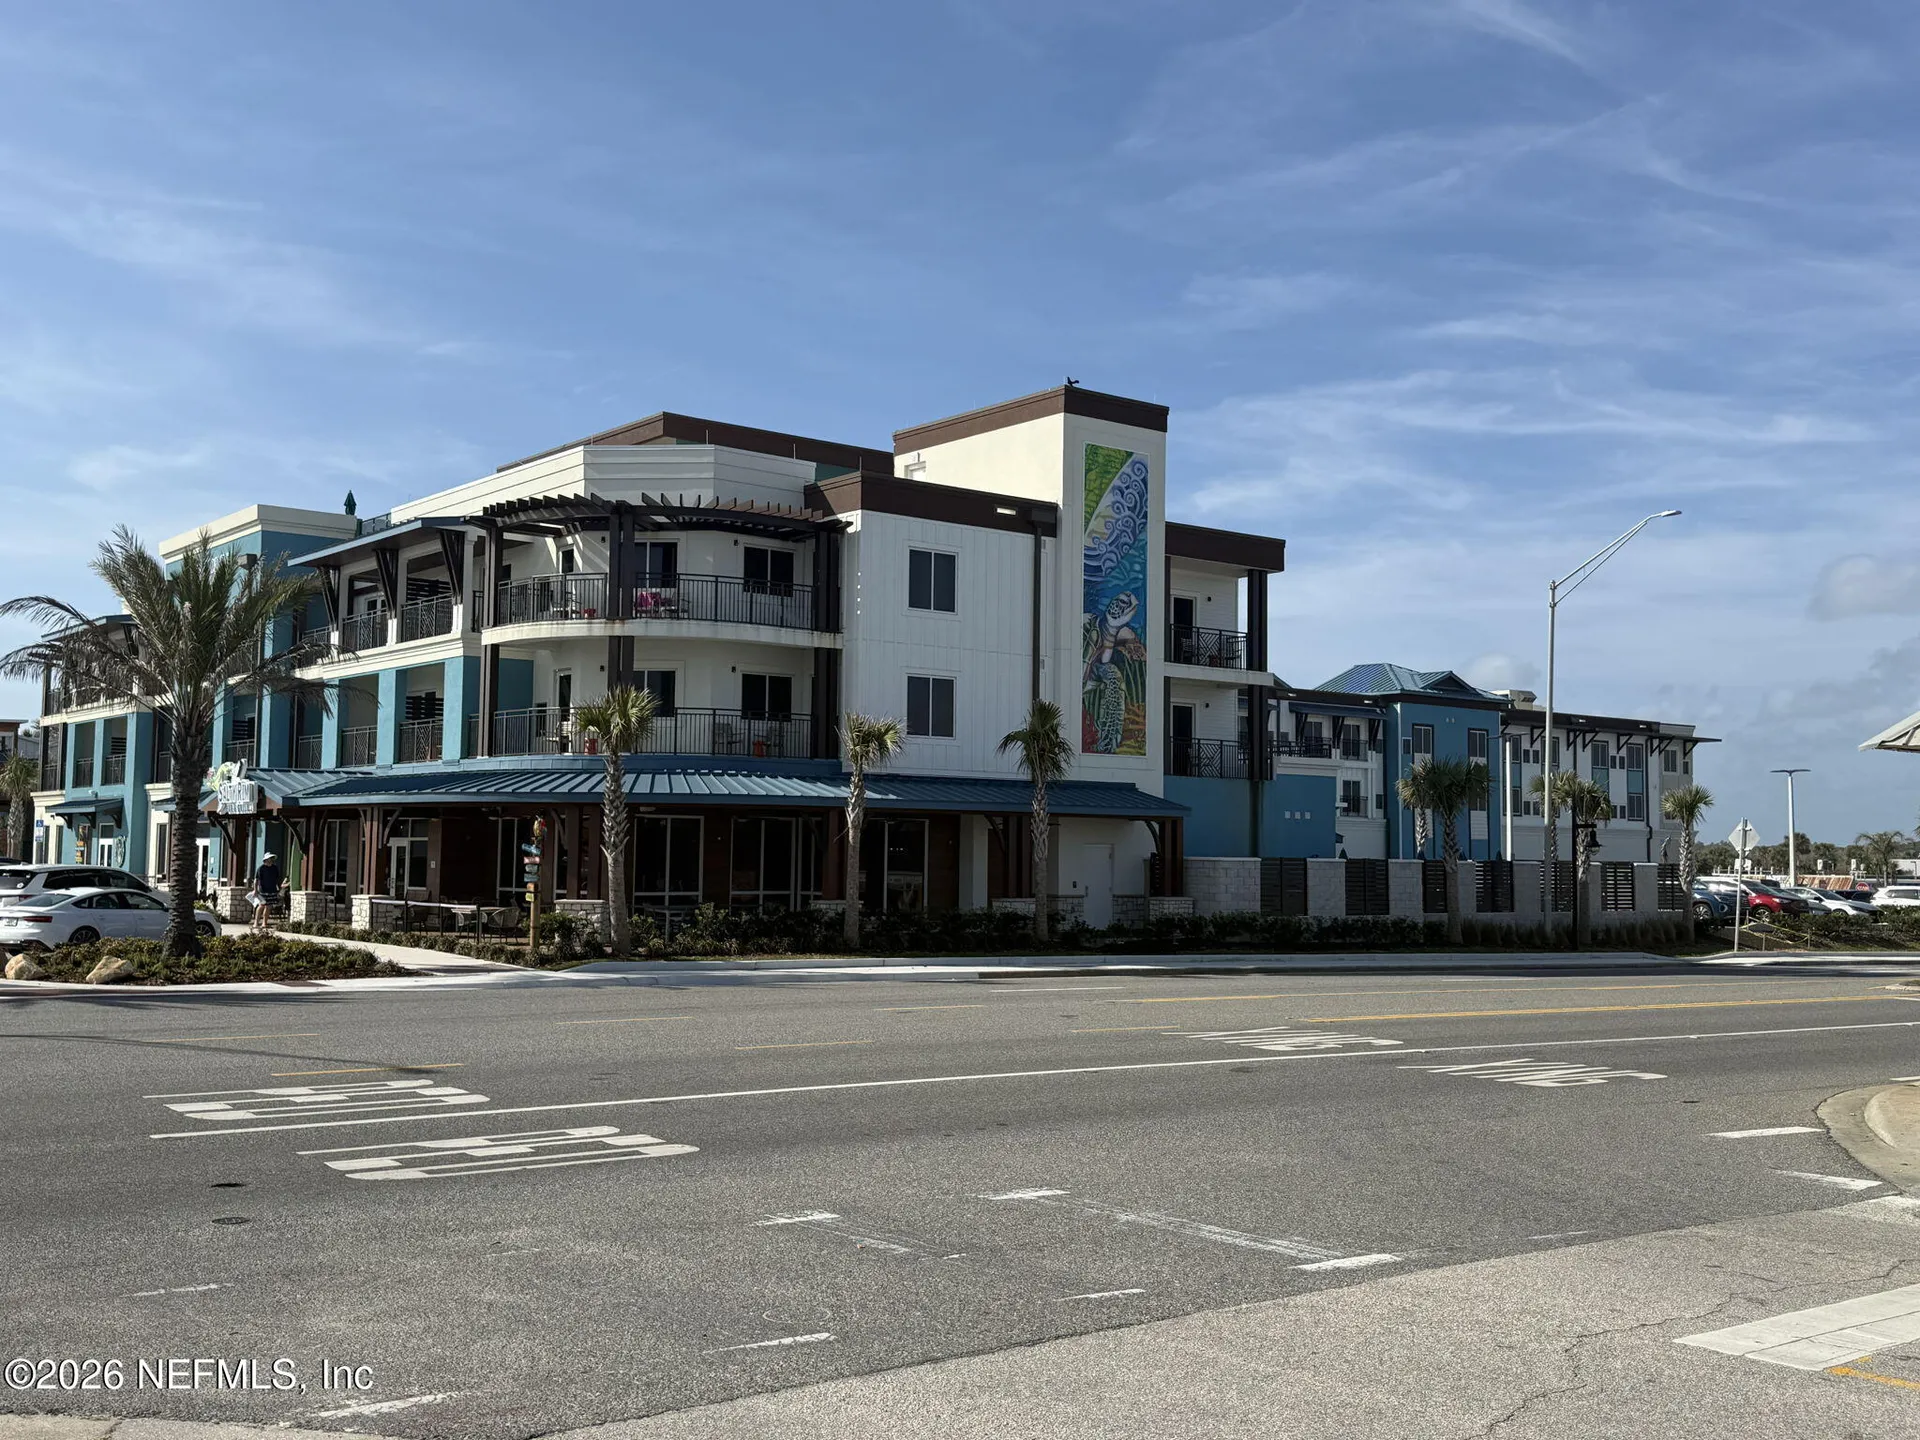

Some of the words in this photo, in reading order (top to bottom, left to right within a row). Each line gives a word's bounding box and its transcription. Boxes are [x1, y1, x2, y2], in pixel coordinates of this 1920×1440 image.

[1160, 1026, 1404, 1051] XING
[1396, 1058, 1668, 1087] XING
[142, 1079, 491, 1120] PED
[296, 1125, 700, 1180] PED
